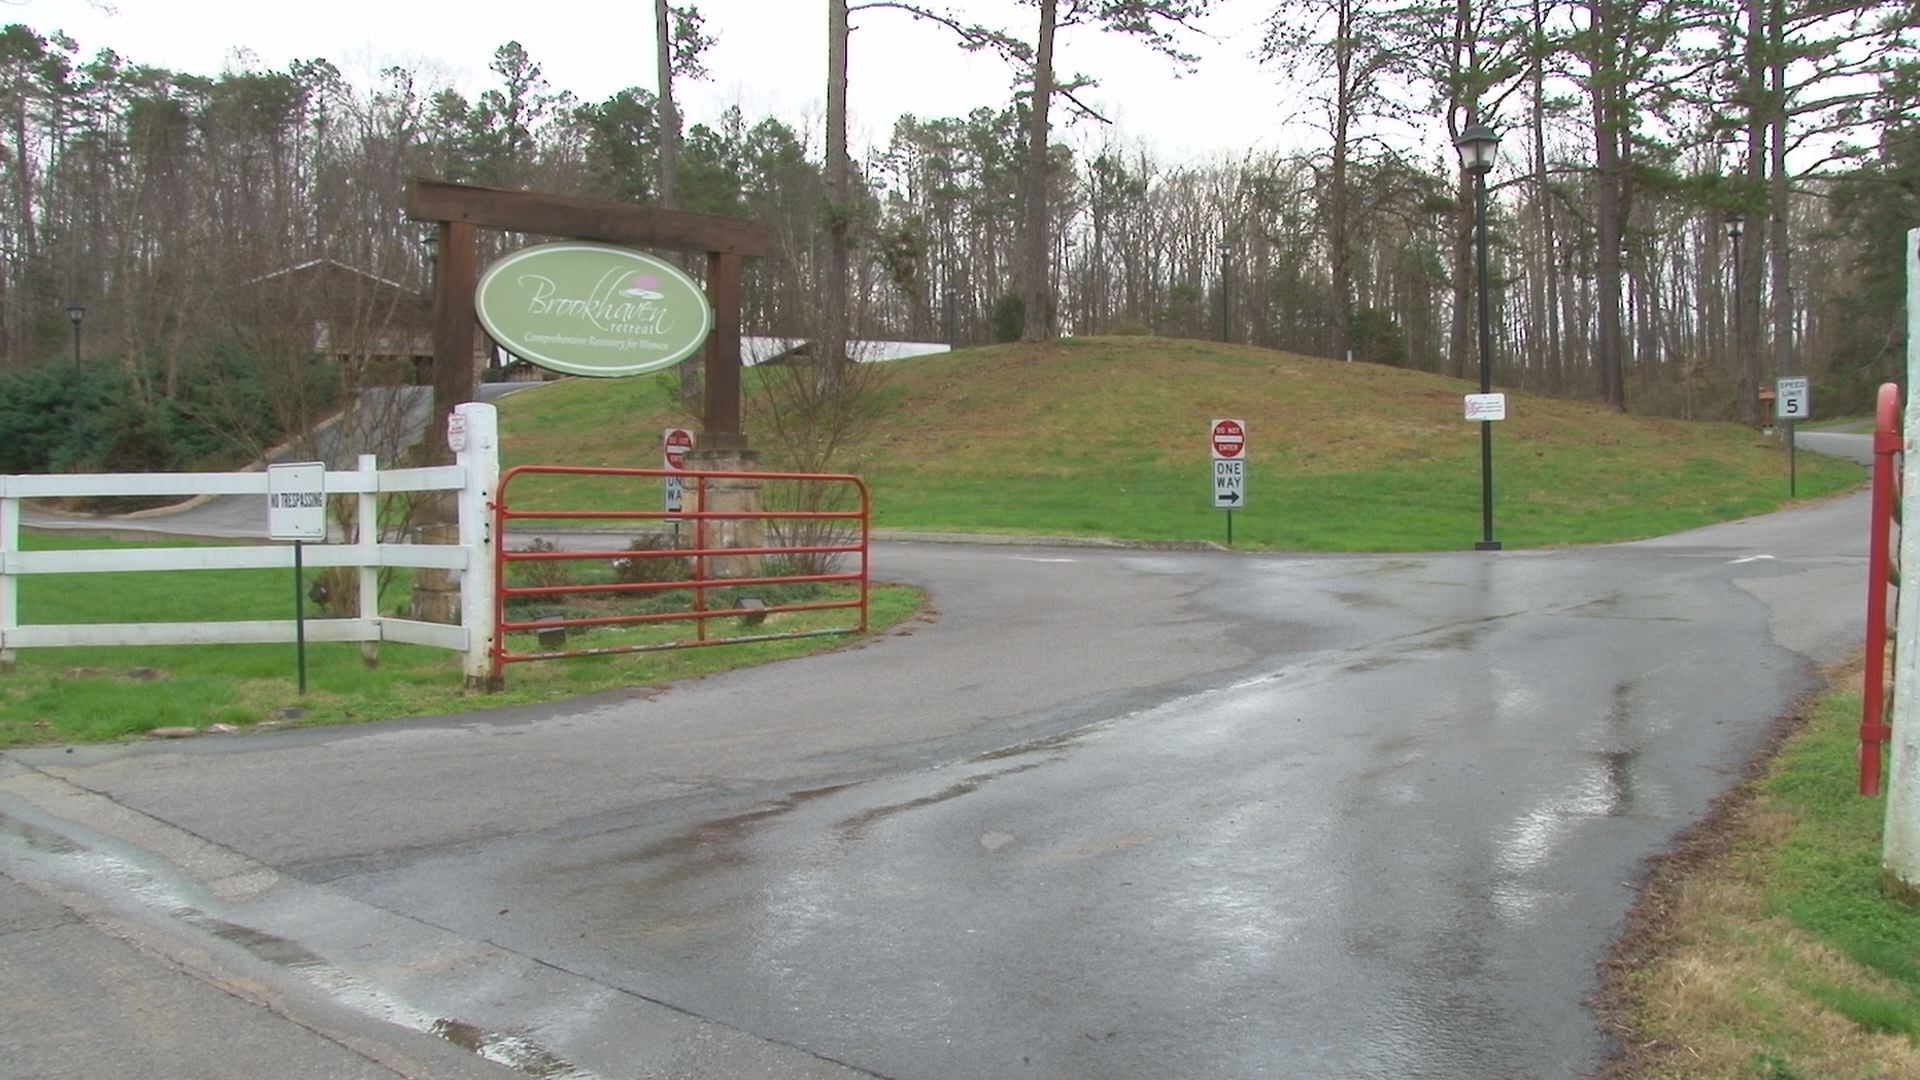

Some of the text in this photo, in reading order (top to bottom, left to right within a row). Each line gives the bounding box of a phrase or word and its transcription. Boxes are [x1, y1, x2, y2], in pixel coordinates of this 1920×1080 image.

[518, 266, 675, 335] Brookhaven
[610, 323, 653, 335] retreat
[1787, 399, 1798, 413] 5
[1217, 463, 1240, 474] ONE
[1217, 477, 1241, 488] WAY
[271, 492, 322, 508] NO TRESPASSING
[668, 489, 682, 500] WA
